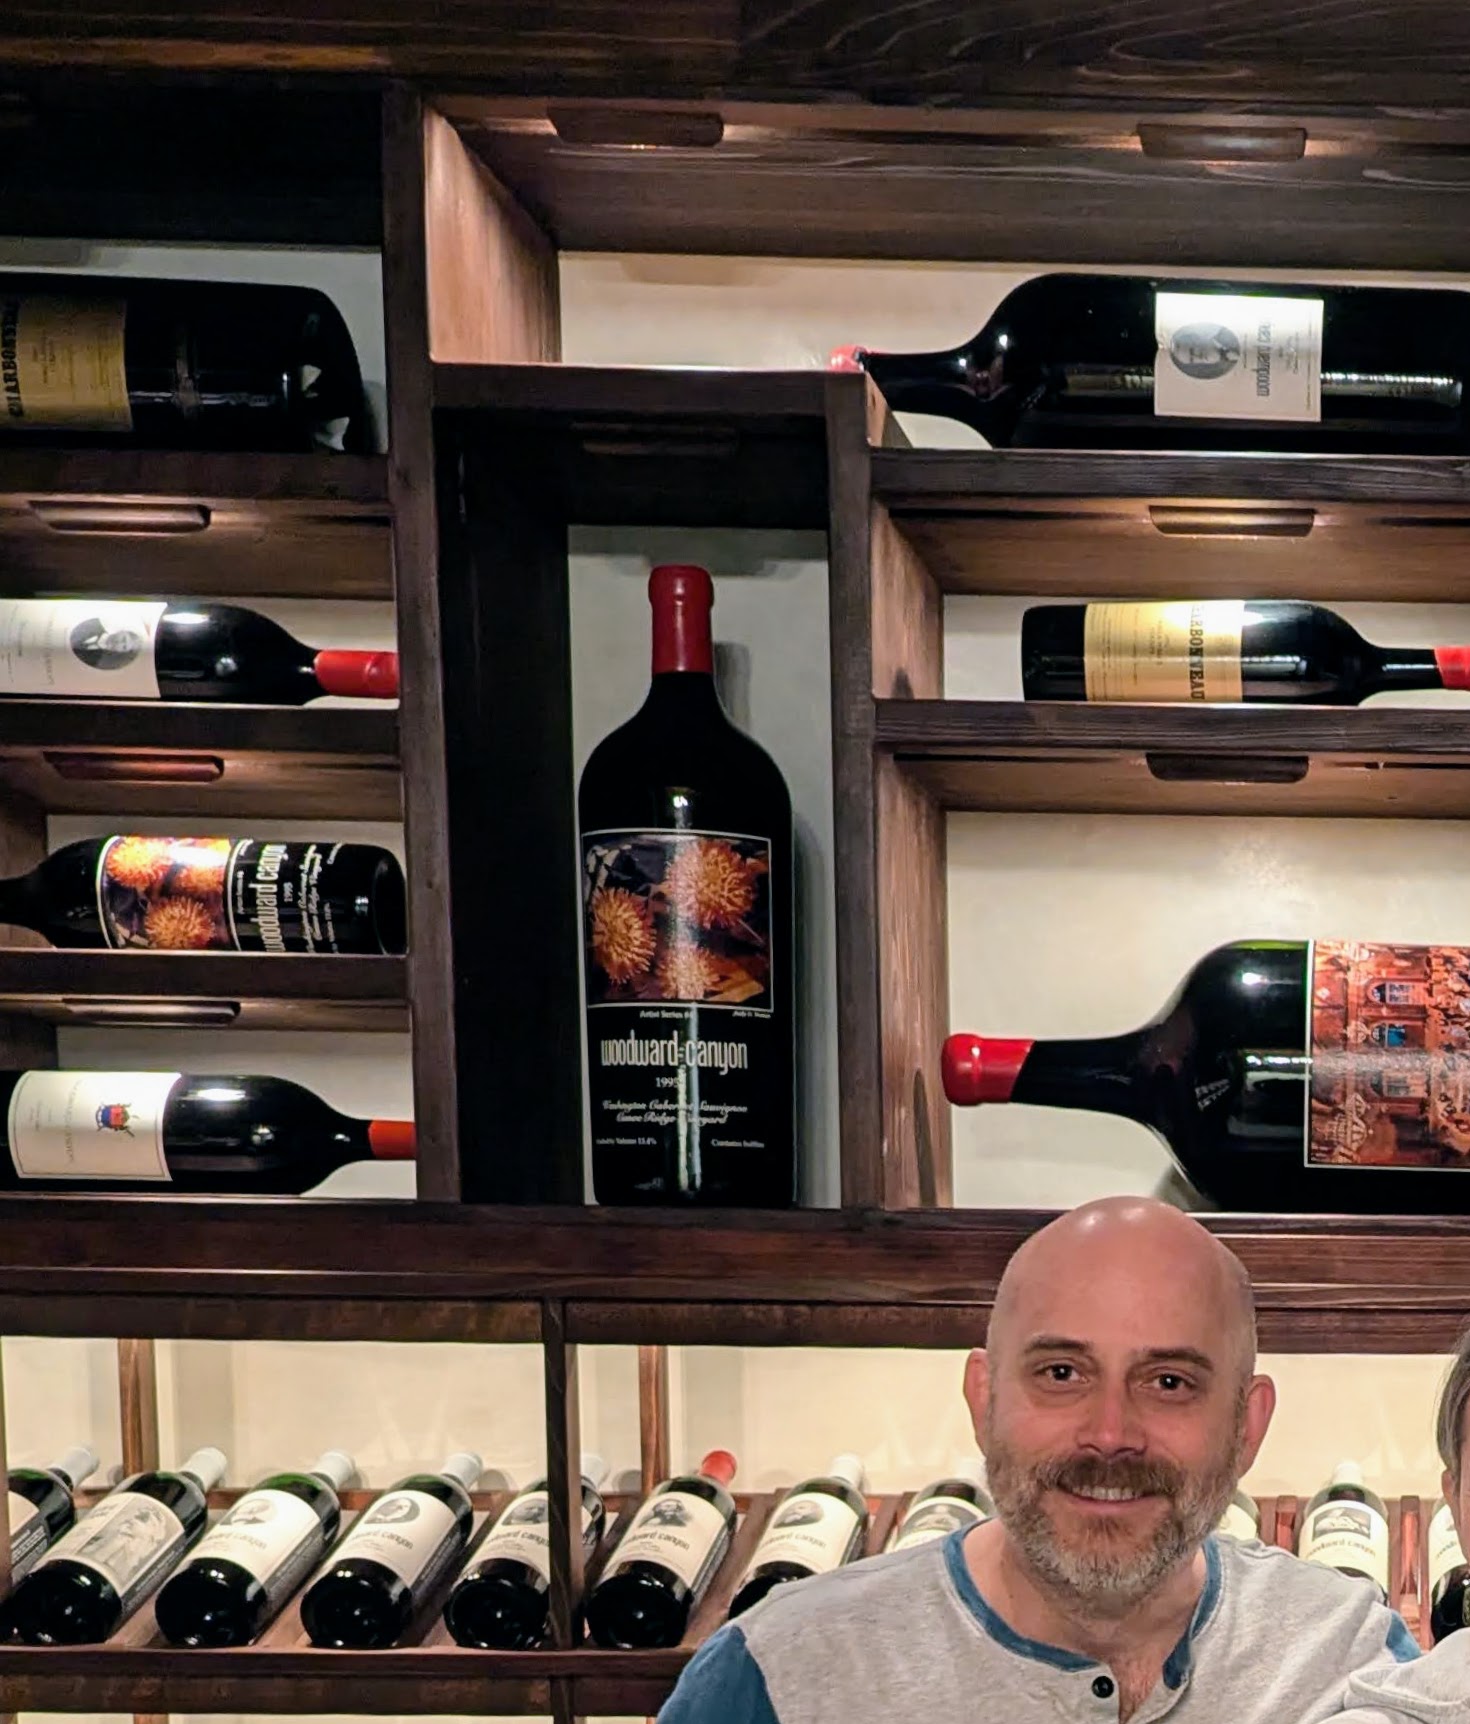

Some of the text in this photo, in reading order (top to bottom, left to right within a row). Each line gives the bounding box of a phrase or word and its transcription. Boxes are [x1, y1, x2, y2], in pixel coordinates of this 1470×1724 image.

[600, 1029, 748, 1076] woodward canyon
[658, 1532, 690, 1551] canyon
